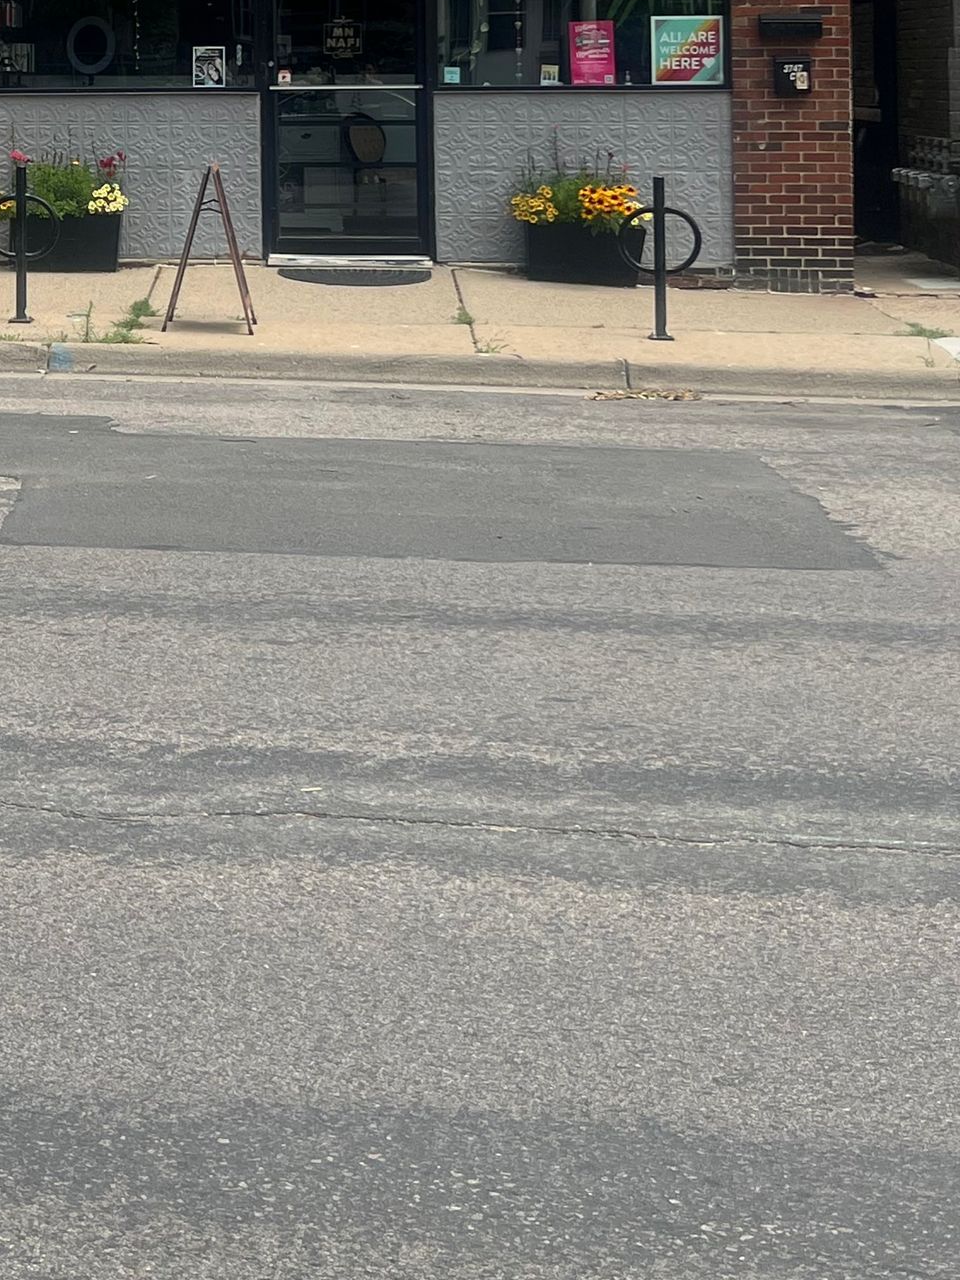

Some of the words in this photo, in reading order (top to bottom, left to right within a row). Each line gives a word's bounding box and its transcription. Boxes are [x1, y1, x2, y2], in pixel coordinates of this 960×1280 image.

[659, 31, 685, 43] ALL
[687, 31, 716, 43] ARE
[659, 45, 717, 55] WELCOME
[660, 57, 701, 70] HERE
